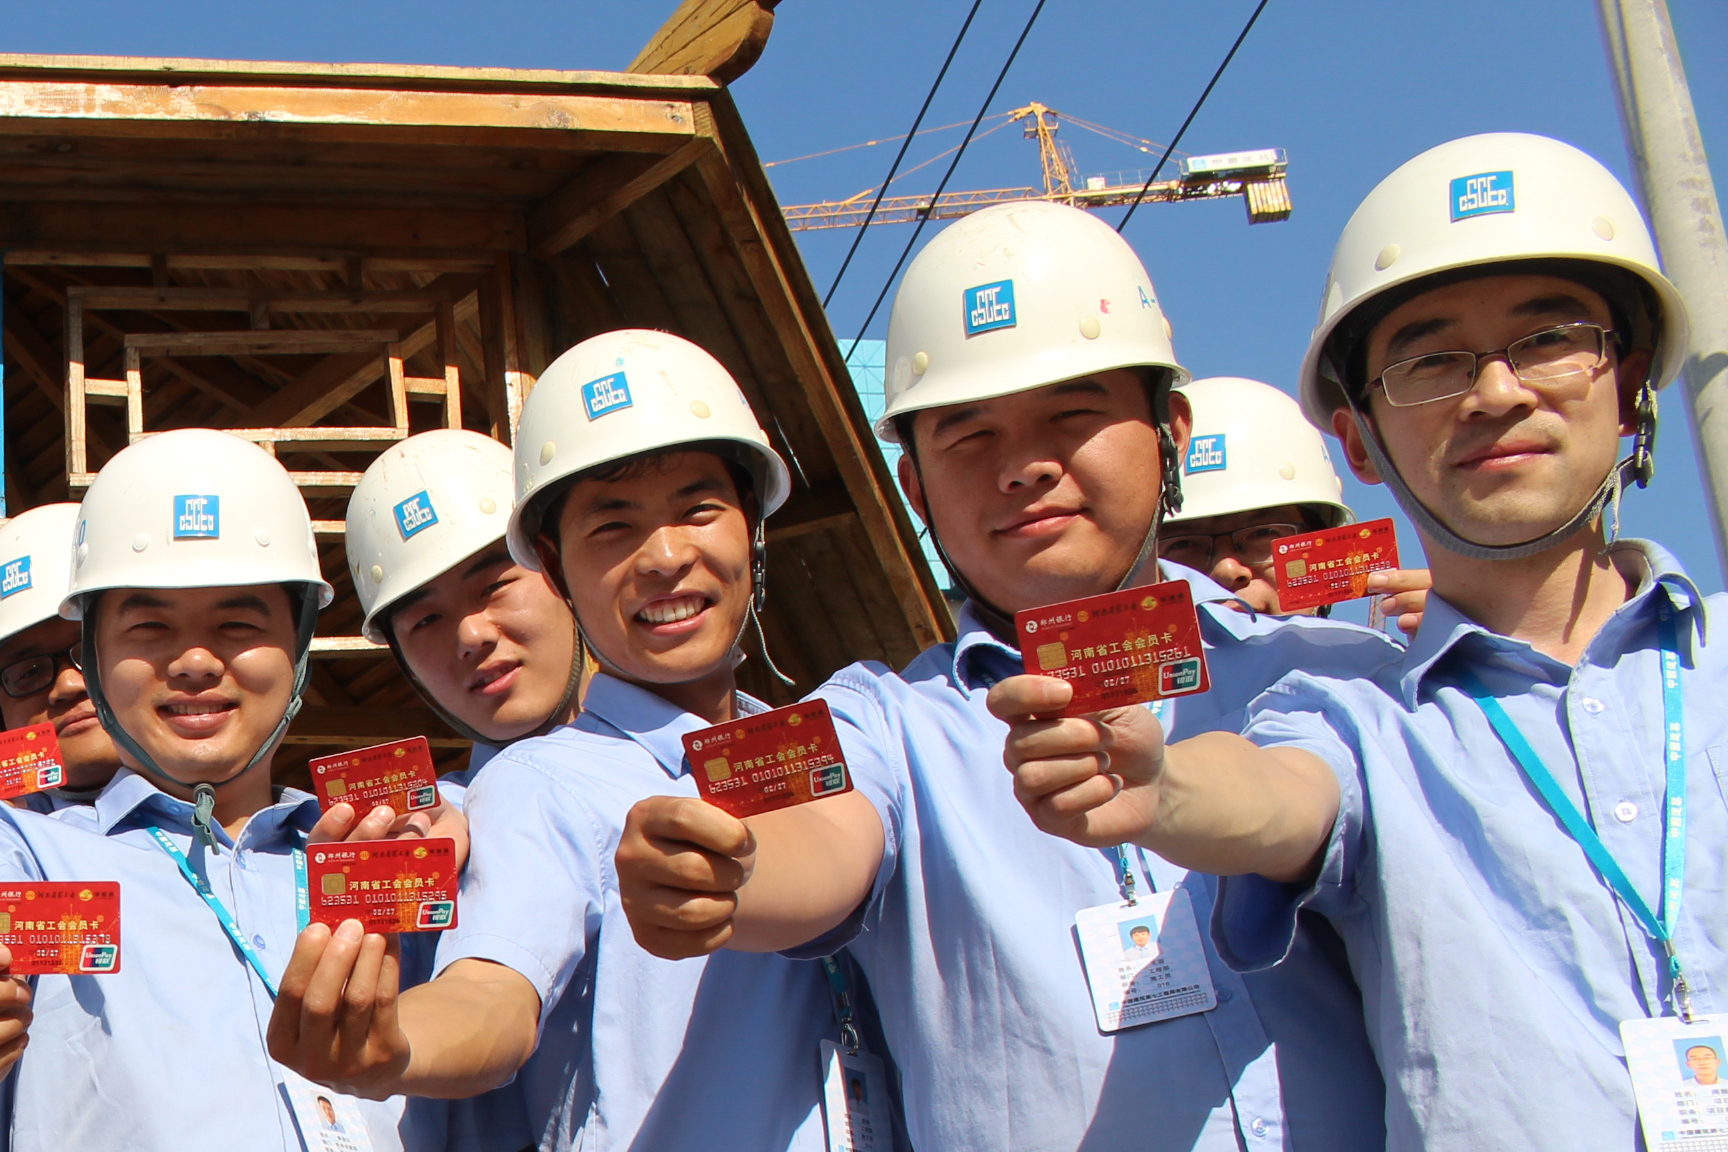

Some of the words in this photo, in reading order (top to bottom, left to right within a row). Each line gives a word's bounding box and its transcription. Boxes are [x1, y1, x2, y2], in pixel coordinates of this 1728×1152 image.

[1459, 176, 1508, 212] CSCEC
[972, 287, 1010, 327] CSCEC
[1309, 551, 1379, 572] 河南省工会会员卡
[1039, 613, 1073, 628] 郑州银行
[1070, 631, 1173, 661] 河南省工会会员卡
[1091, 645, 1191, 675] 0101011315261
[1103, 675, 1130, 687] 02/27
[1162, 666, 1196, 682] UnionPay
[732, 742, 819, 773] 河南省工会会员卡
[348, 769, 416, 791] 河南省工会会员卡
[708, 775, 747, 794] 623531
[751, 753, 835, 783] 0101011315394
[812, 770, 842, 785] UnionPay
[362, 778, 428, 798] 0101011315204
[763, 781, 786, 793] 02/27
[410, 790, 432, 801] UnionPay
[349, 877, 435, 891] 河南省工会会员卡
[321, 895, 358, 906] 623531
[365, 890, 447, 903] 0101011315295
[373, 907, 395, 915] 02/27
[421, 907, 449, 917] UnionPay
[14, 920, 99, 930] 河南省工会会员卡
[29, 934, 110, 944] 0101011315378
[85, 951, 112, 960] UnionPay
